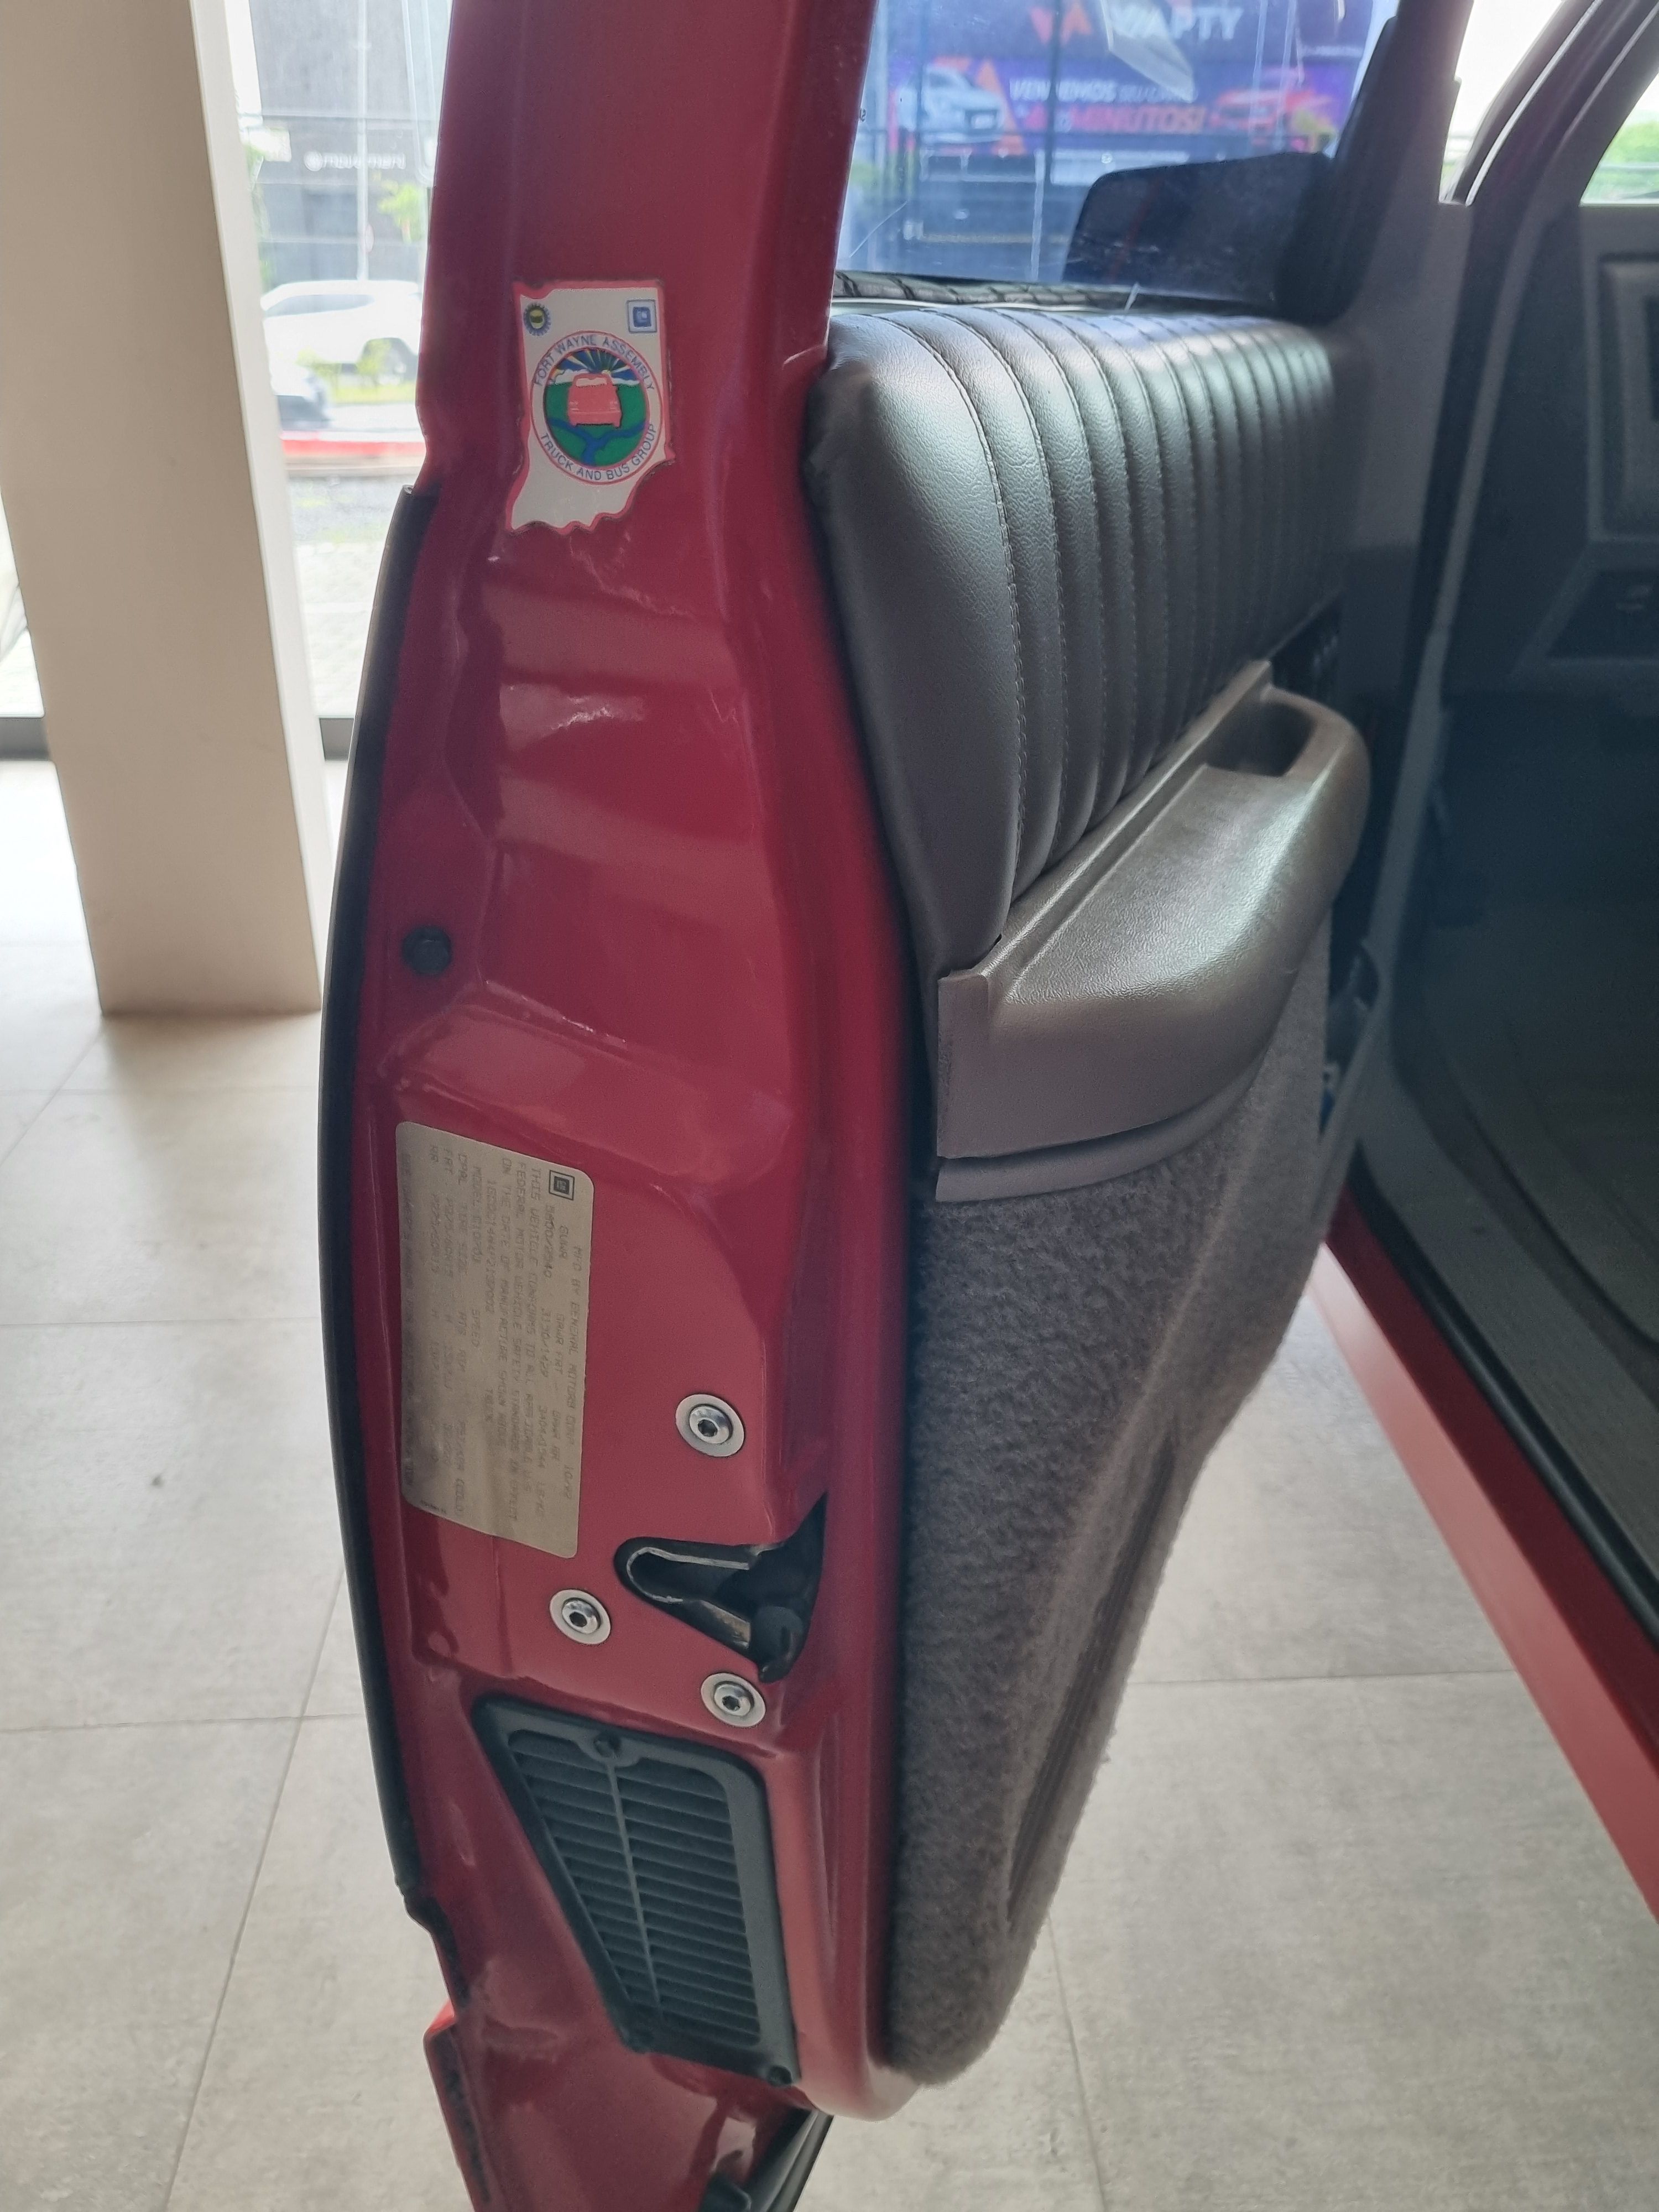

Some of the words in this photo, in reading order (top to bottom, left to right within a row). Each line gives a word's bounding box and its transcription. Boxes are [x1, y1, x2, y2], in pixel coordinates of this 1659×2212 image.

[534, 351, 555, 386] FORT
[555, 335, 597, 354] WAYNE
[602, 335, 655, 389] ASSEMBLY
[540, 432, 574, 470] TRUCK
[576, 467, 602, 481] AND
[606, 465, 630, 481] BUS
[631, 424, 658, 466] GROUP
[530, 1167, 541, 1201] THIS
